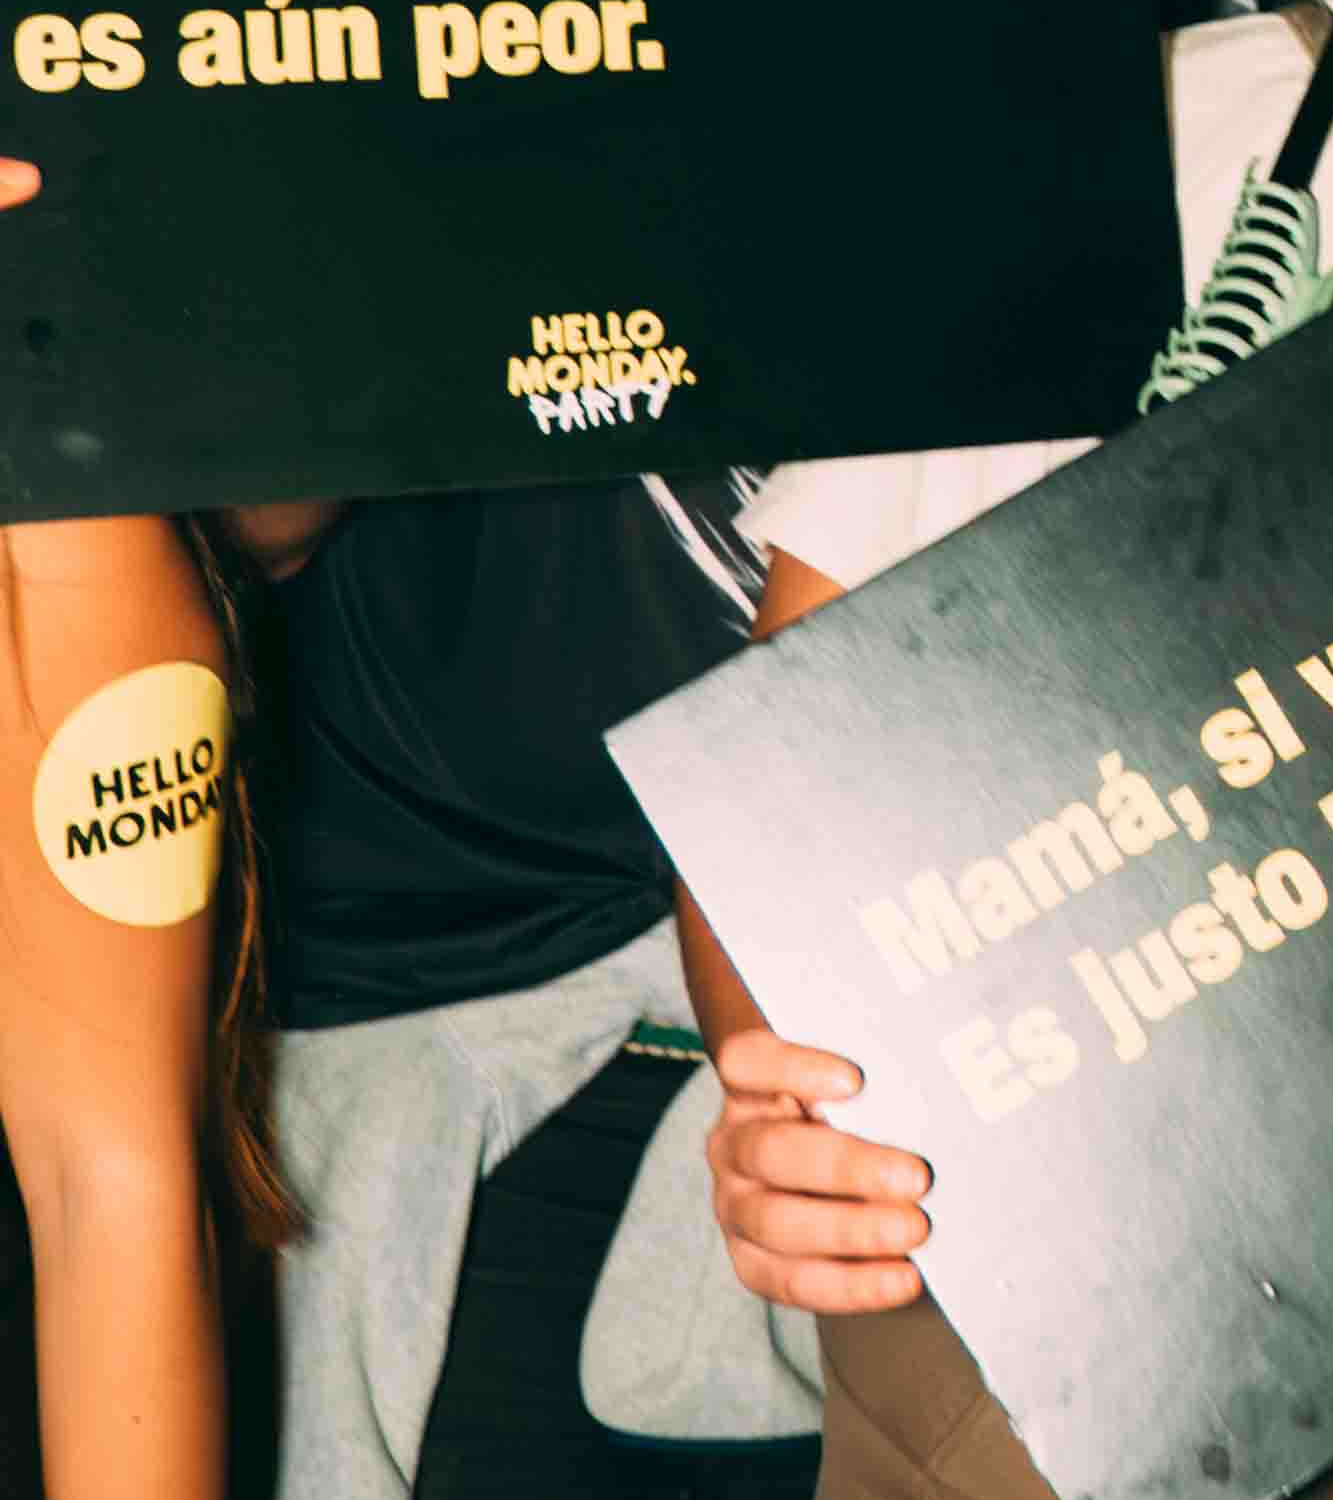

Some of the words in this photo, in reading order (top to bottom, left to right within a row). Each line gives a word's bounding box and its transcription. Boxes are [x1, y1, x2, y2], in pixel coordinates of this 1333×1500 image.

[12, 8, 145, 92] es
[531, 309, 665, 355] HELLO
[507, 346, 697, 397] MONDAY.
[529, 375, 672, 435] PARTY
[92, 737, 214, 807] HELLO
[858, 749, 1211, 997] Mamá,
[1201, 668, 1307, 788] si
[938, 1005, 1081, 1124] Es
[1068, 848, 1329, 1064] justo
